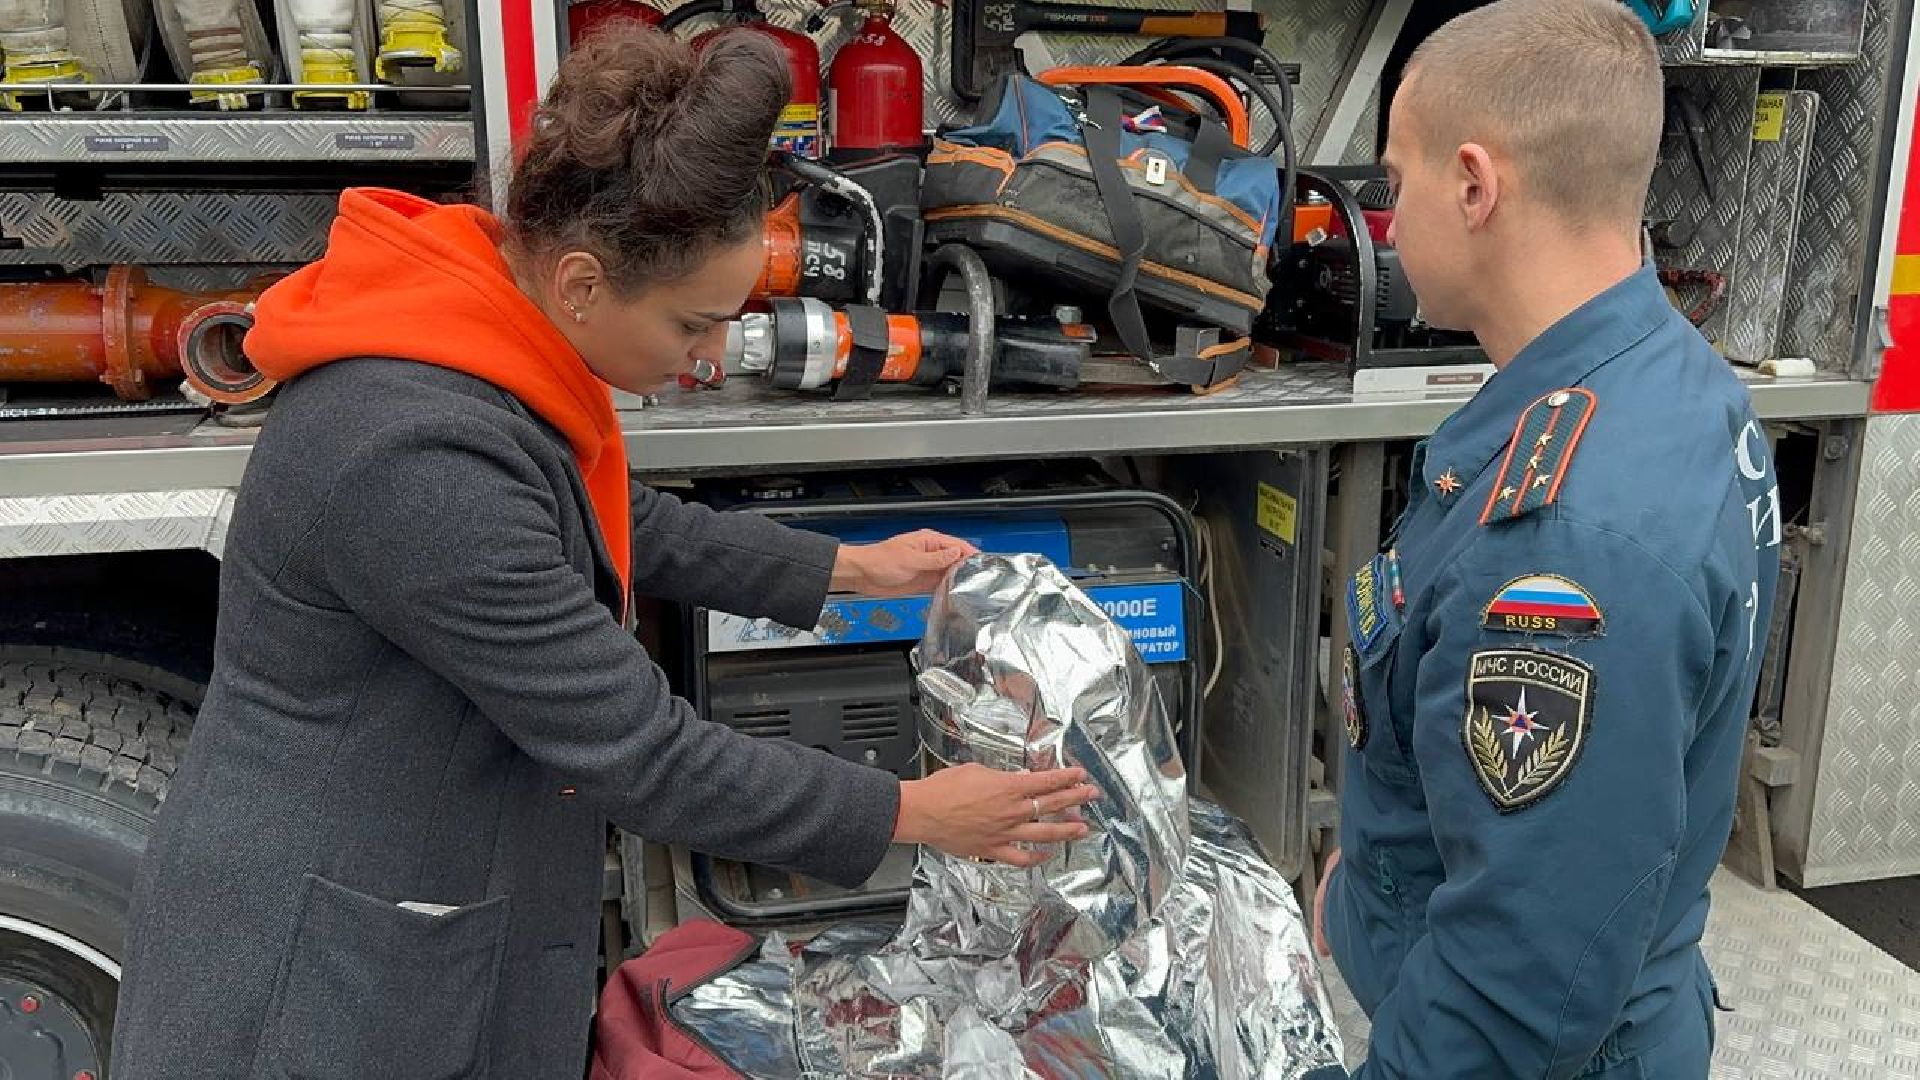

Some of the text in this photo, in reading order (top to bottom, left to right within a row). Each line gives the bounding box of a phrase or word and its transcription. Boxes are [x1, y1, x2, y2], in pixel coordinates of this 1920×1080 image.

[823, 242, 846, 280] 58
[1097, 597, 1157, 618] 000E
[1505, 614, 1556, 629] RUSS
[1475, 657, 1583, 692] МЧС РОССИИ
